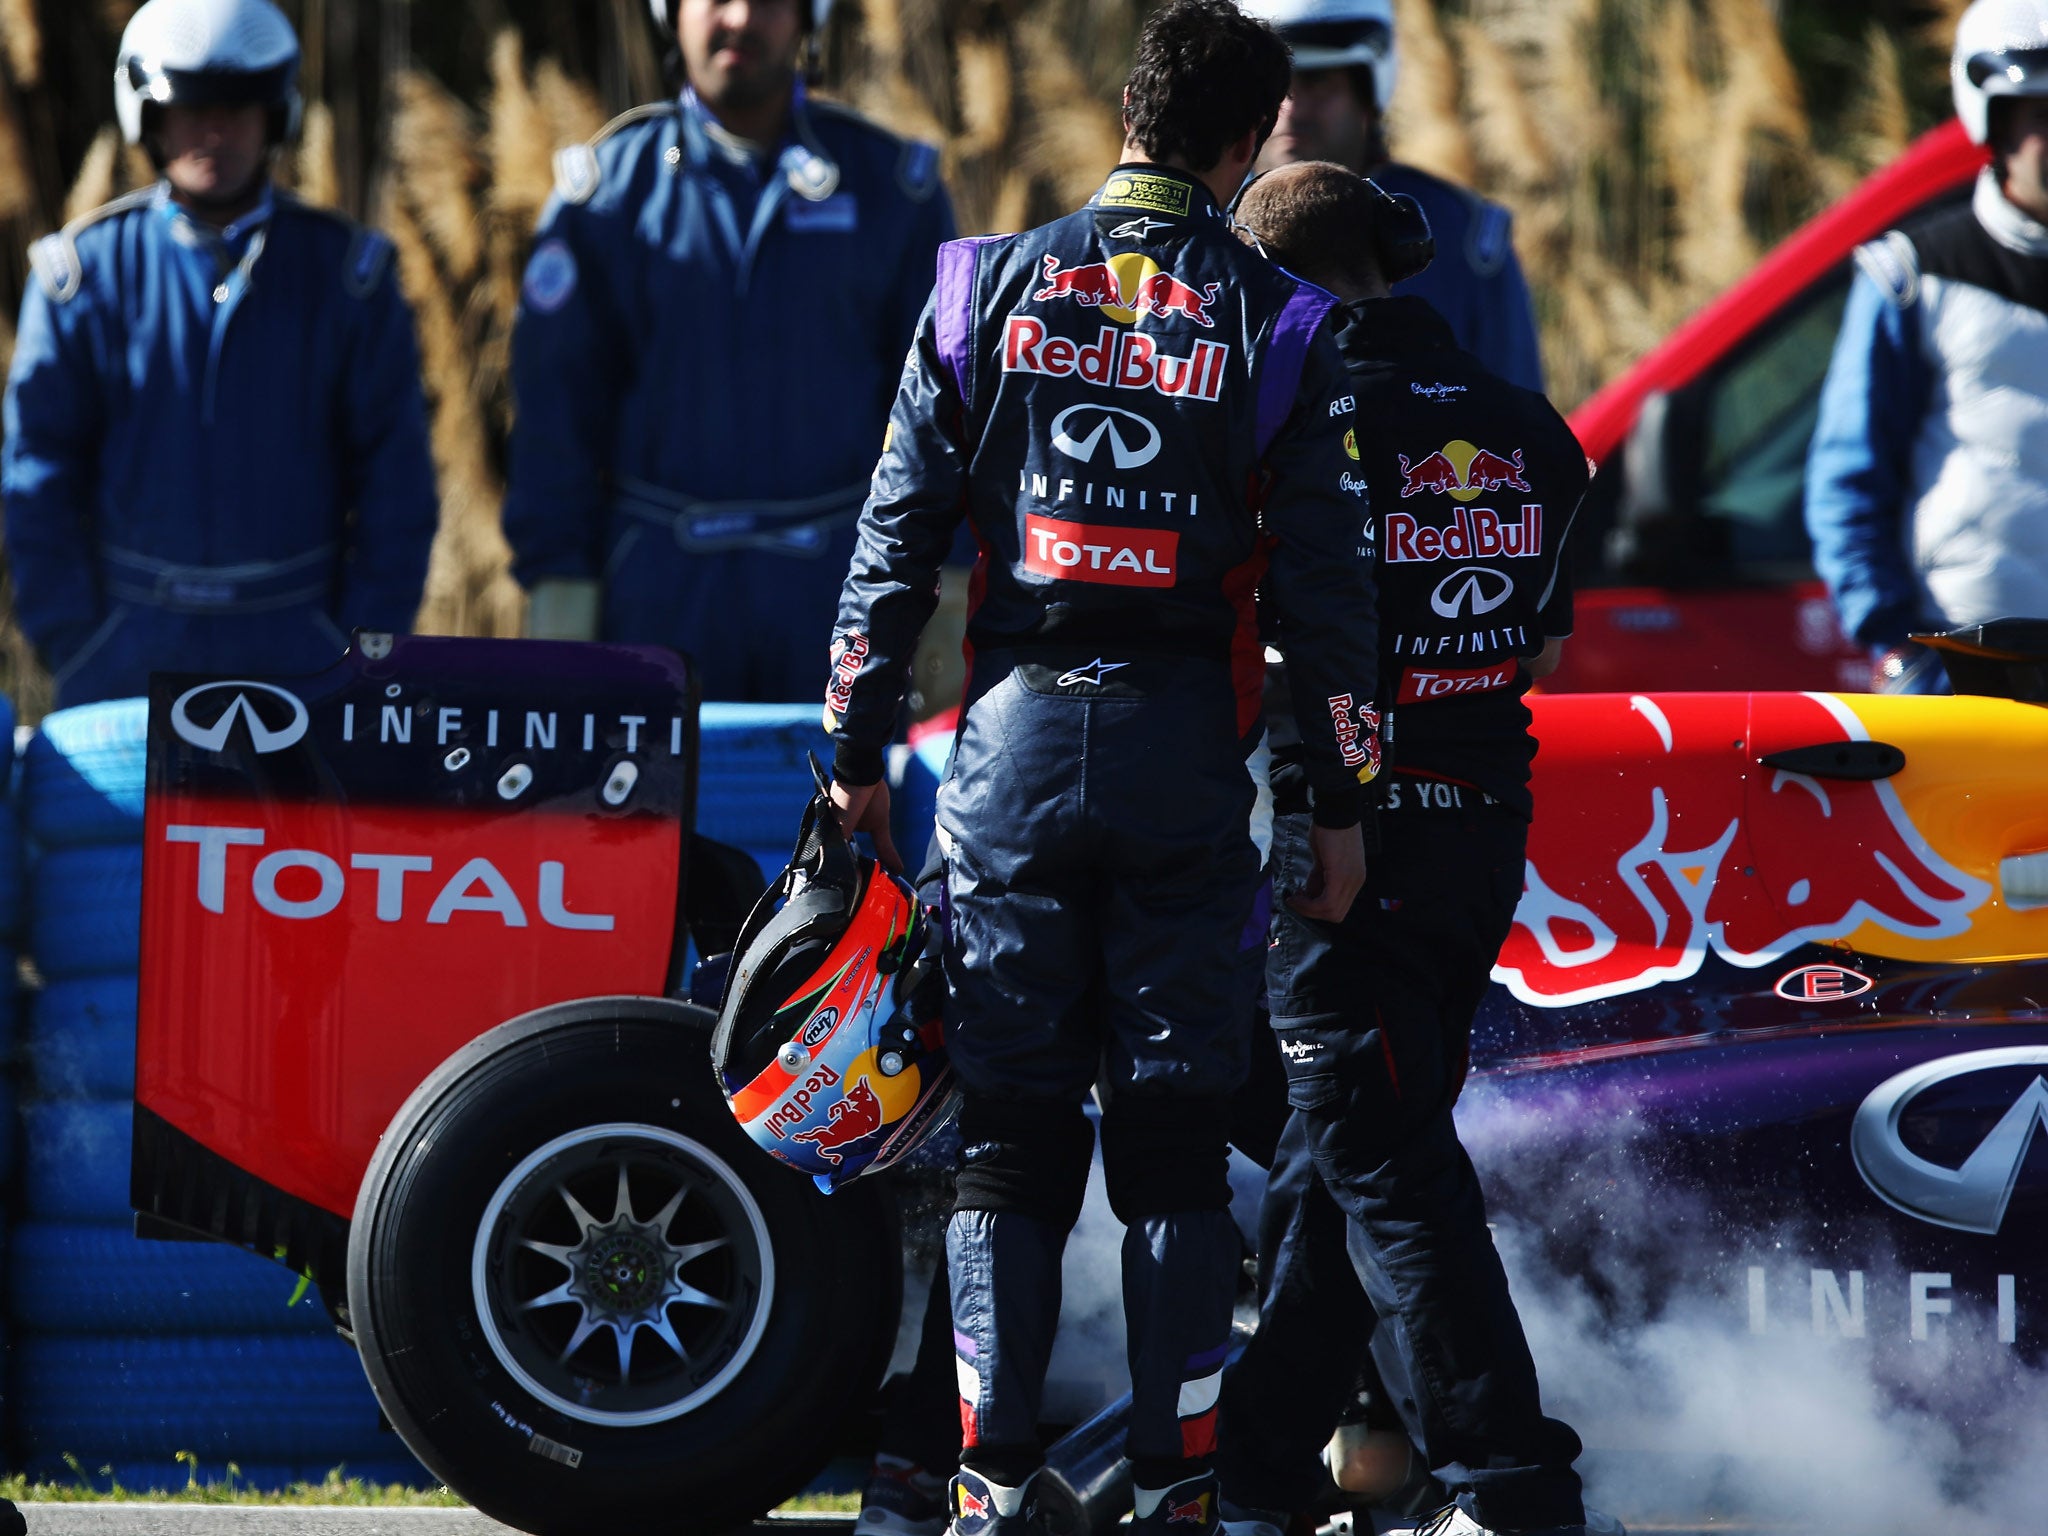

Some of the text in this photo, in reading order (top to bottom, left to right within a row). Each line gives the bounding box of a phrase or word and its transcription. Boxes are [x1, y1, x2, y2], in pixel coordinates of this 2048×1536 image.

[1020, 469, 1197, 516] INFINITI
[1031, 527, 1170, 574] TOTAL
[1394, 625, 1526, 655] INFINITI
[1411, 671, 1509, 697] TOTAL
[343, 703, 682, 755] INFINITI
[166, 825, 615, 931] TOTAL
[806, 1009, 834, 1044] Arai
